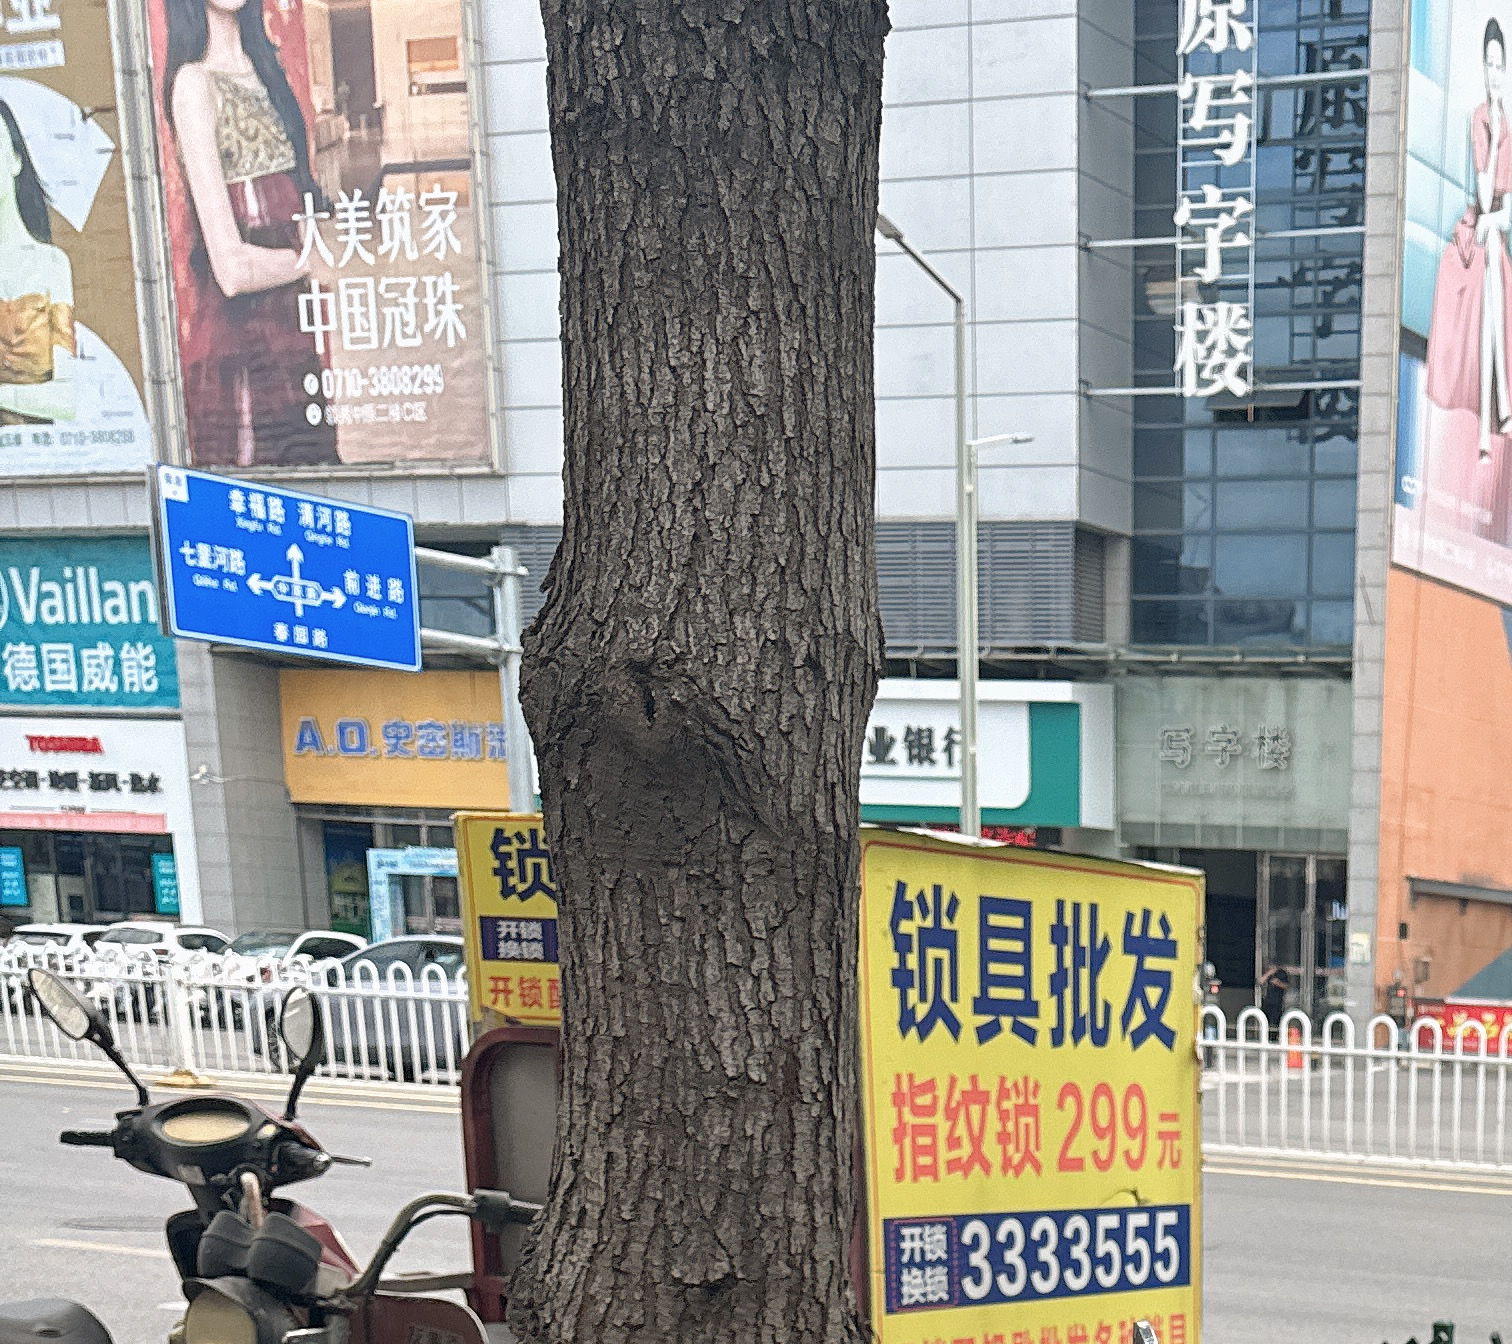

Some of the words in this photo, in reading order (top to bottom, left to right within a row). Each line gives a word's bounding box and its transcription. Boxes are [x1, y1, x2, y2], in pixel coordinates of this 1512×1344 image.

[291, 184, 463, 269] 大美筑家
[297, 271, 467, 356] 中国冠珠
[8, 566, 160, 625] Vaillan
[343, 568, 405, 605] 前进路
[2, 641, 159, 693] 德国威能
[1159, 722, 1292, 771] 写字楼
[489, 828, 558, 901] 锁
[496, 920, 543, 939] 开锁
[889, 879, 1179, 1051] 锁具批发
[891, 1071, 1043, 1183] 指纹锁
[899, 1224, 948, 1263] 开锁
[960, 1210, 1181, 1301] 3333555
[900, 1266, 951, 1306] 换锁
